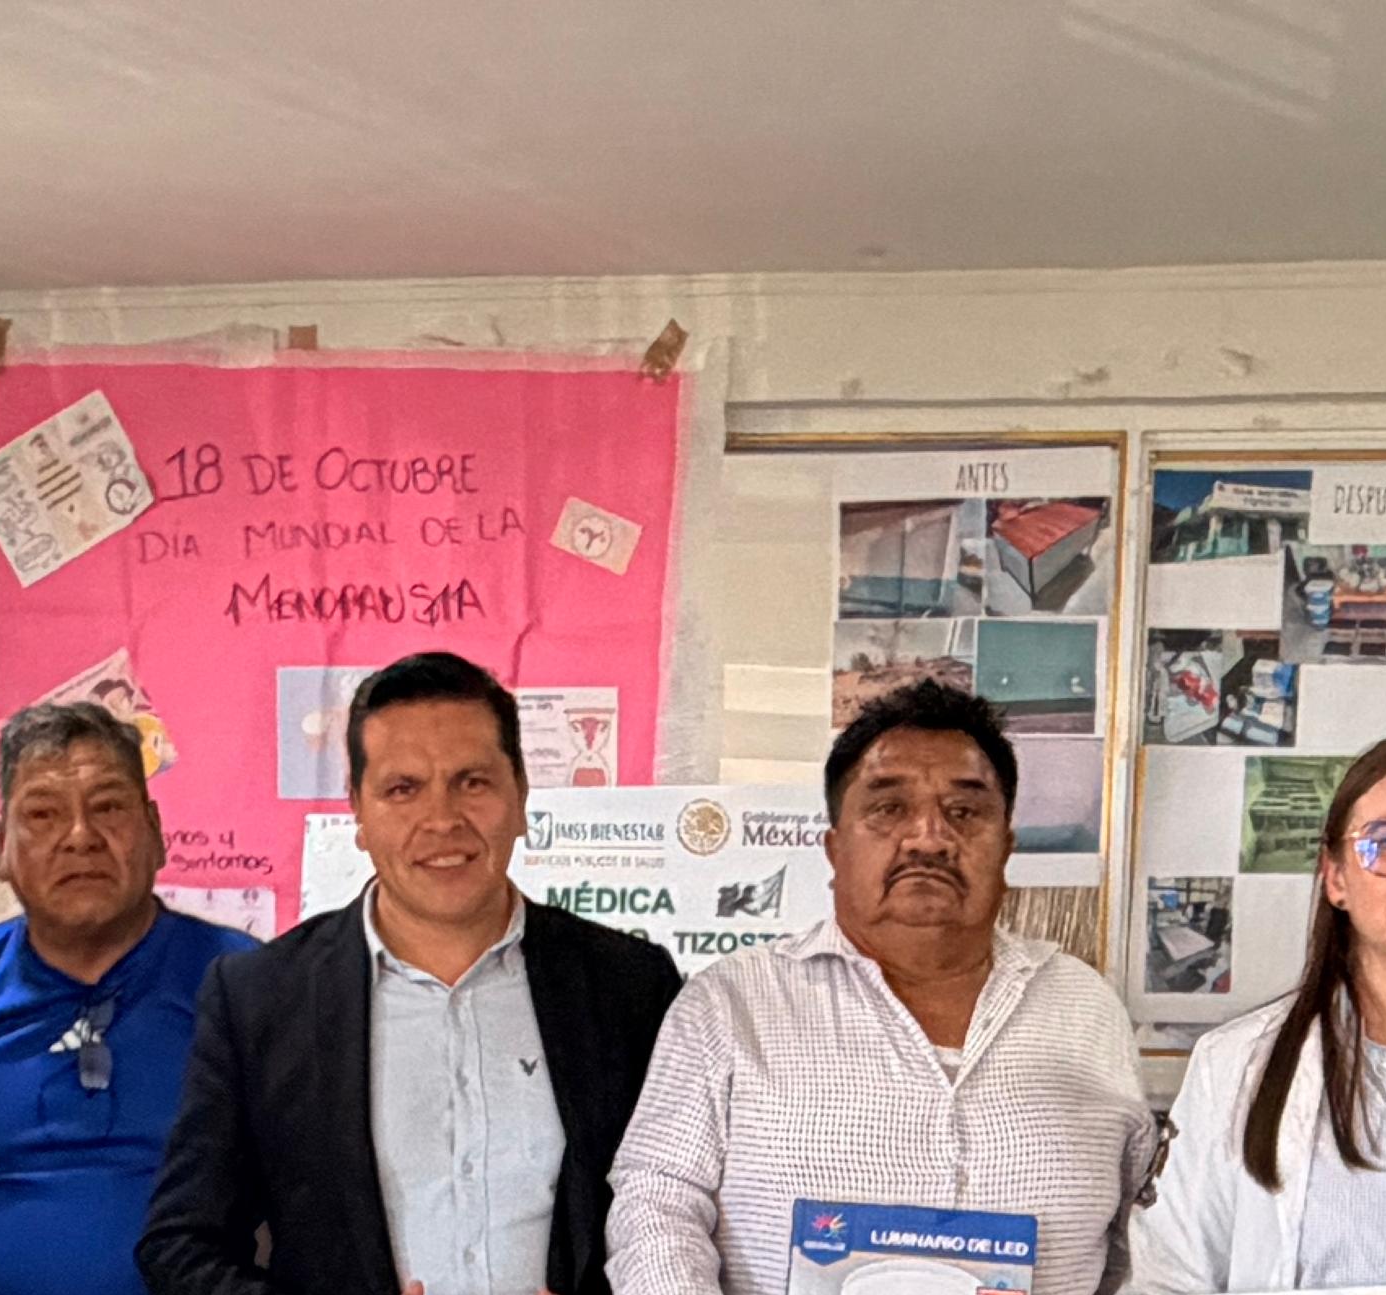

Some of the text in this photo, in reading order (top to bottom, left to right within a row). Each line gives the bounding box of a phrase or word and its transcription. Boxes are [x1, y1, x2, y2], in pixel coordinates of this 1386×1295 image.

[166, 442, 224, 498] 18
[242, 452, 299, 496] DE
[955, 462, 1009, 492] ANTES
[244, 520, 398, 559] MUNDIAL
[420, 516, 463, 547] DE
[478, 506, 526, 542] LA
[555, 822, 665, 841] IMSS BIENESTAR
[741, 811, 810, 825] Gobierno
[545, 880, 676, 916] MÉDICA
[994, 1240, 1030, 1258] LED
